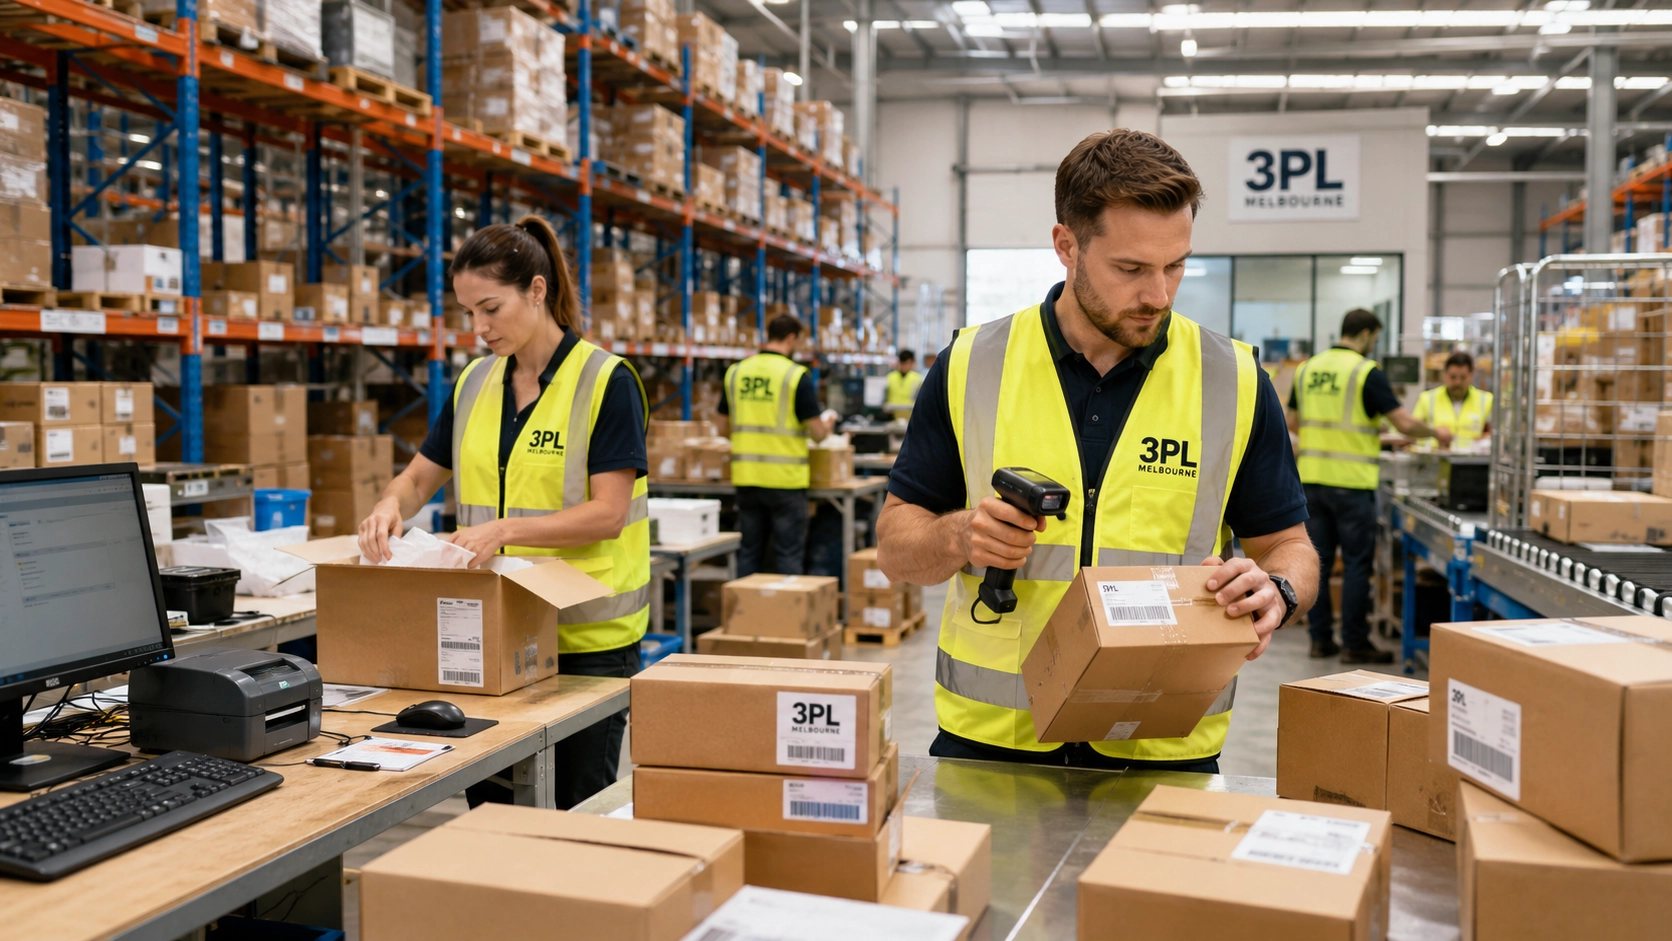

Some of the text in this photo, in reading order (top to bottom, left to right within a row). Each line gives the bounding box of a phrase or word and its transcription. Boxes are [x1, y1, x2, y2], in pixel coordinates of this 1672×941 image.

[1245, 148, 1344, 192] 3PL
[1244, 196, 1344, 208] MELBOURNE
[740, 376, 774, 396] 3PL
[1308, 371, 1340, 391] 3PL
[529, 430, 564, 450] 3PL
[1139, 437, 1198, 468] 3PL
[1138, 464, 1197, 478] MELBOURNE
[792, 702, 840, 726] 3PL
[791, 726, 840, 735] MELBOURNE
